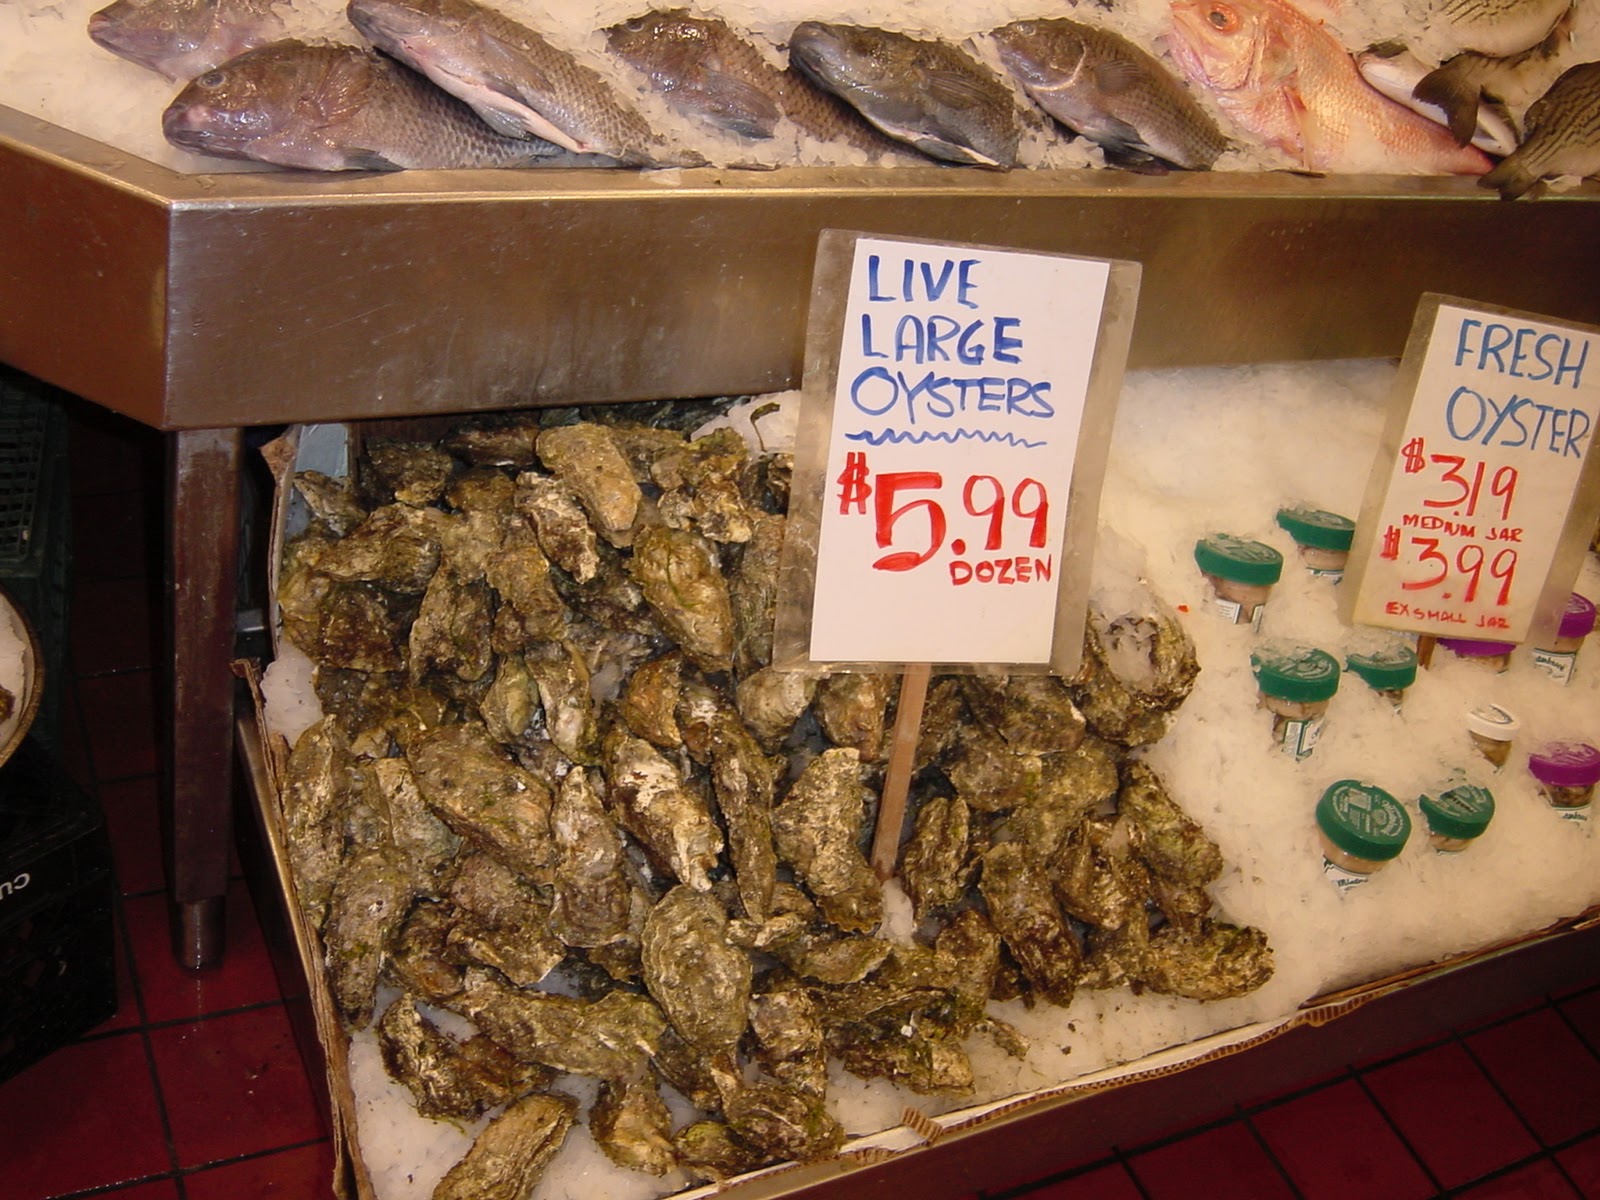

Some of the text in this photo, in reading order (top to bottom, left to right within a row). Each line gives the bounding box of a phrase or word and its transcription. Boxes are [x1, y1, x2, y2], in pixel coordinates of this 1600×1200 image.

[868, 255, 980, 309] LIVE
[861, 314, 1023, 366] LARGE
[1455, 318, 1589, 389] FRESH
[850, 366, 1054, 424] OYSTERS
[1446, 386, 1589, 458] OYSTER
[837, 452, 1050, 571] $5.99
[1485, 528, 1523, 542] JAR
[949, 553, 1051, 586] DOZEN
[1380, 525, 1518, 605] $3.99
[1475, 615, 1510, 629] JAR
